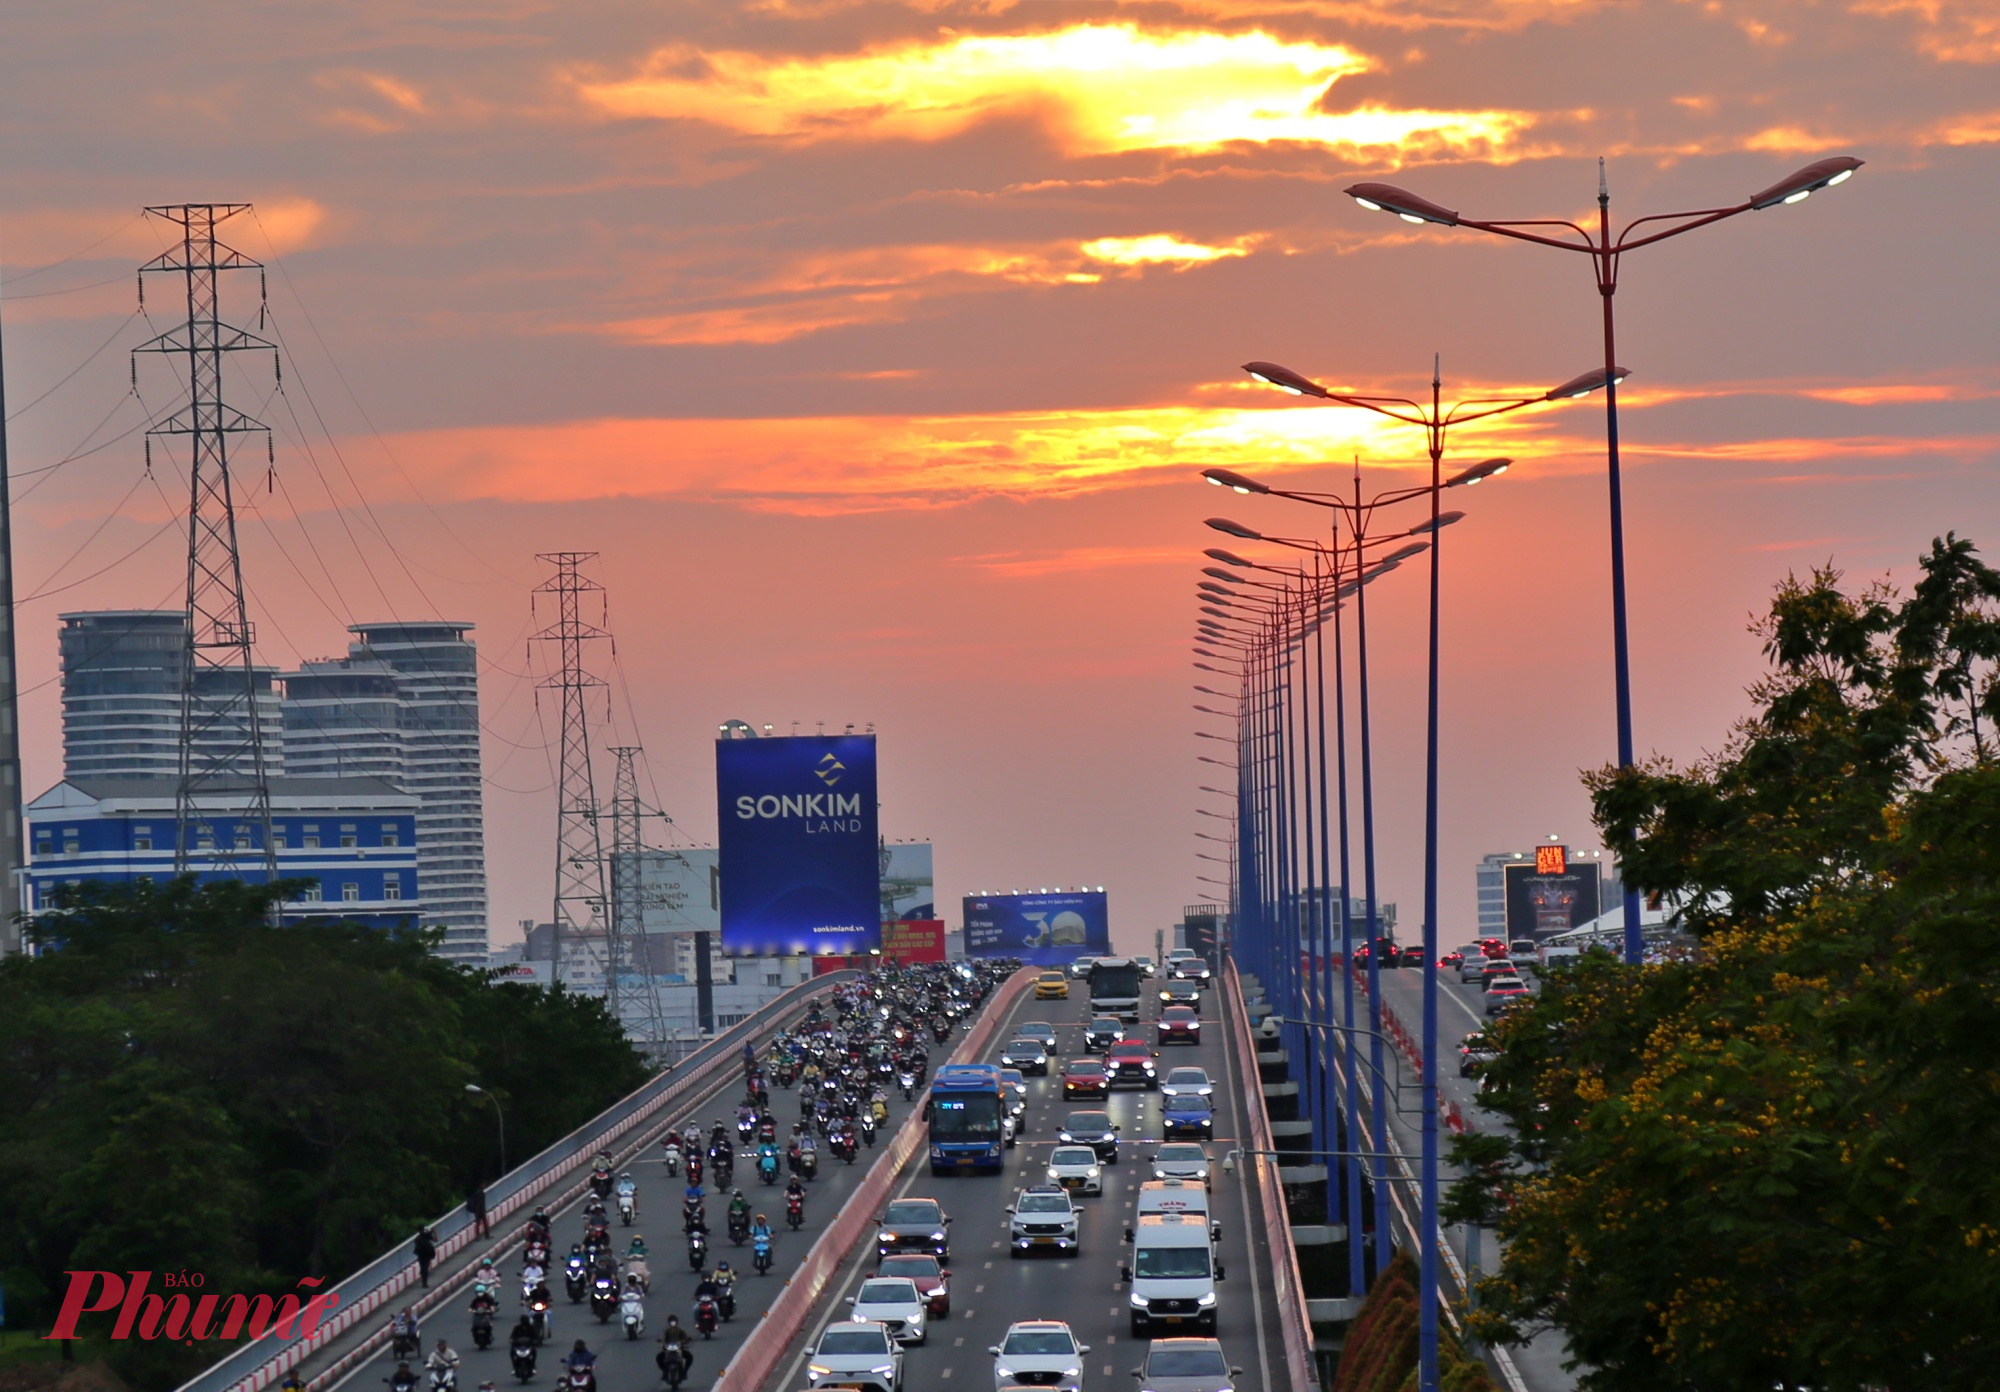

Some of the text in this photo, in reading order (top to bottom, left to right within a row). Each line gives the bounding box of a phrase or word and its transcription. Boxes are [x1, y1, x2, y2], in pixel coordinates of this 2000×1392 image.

[736, 793, 861, 819] SONKIM
[806, 820, 862, 834] LAND
[813, 924, 865, 934] sonkimland.vn
